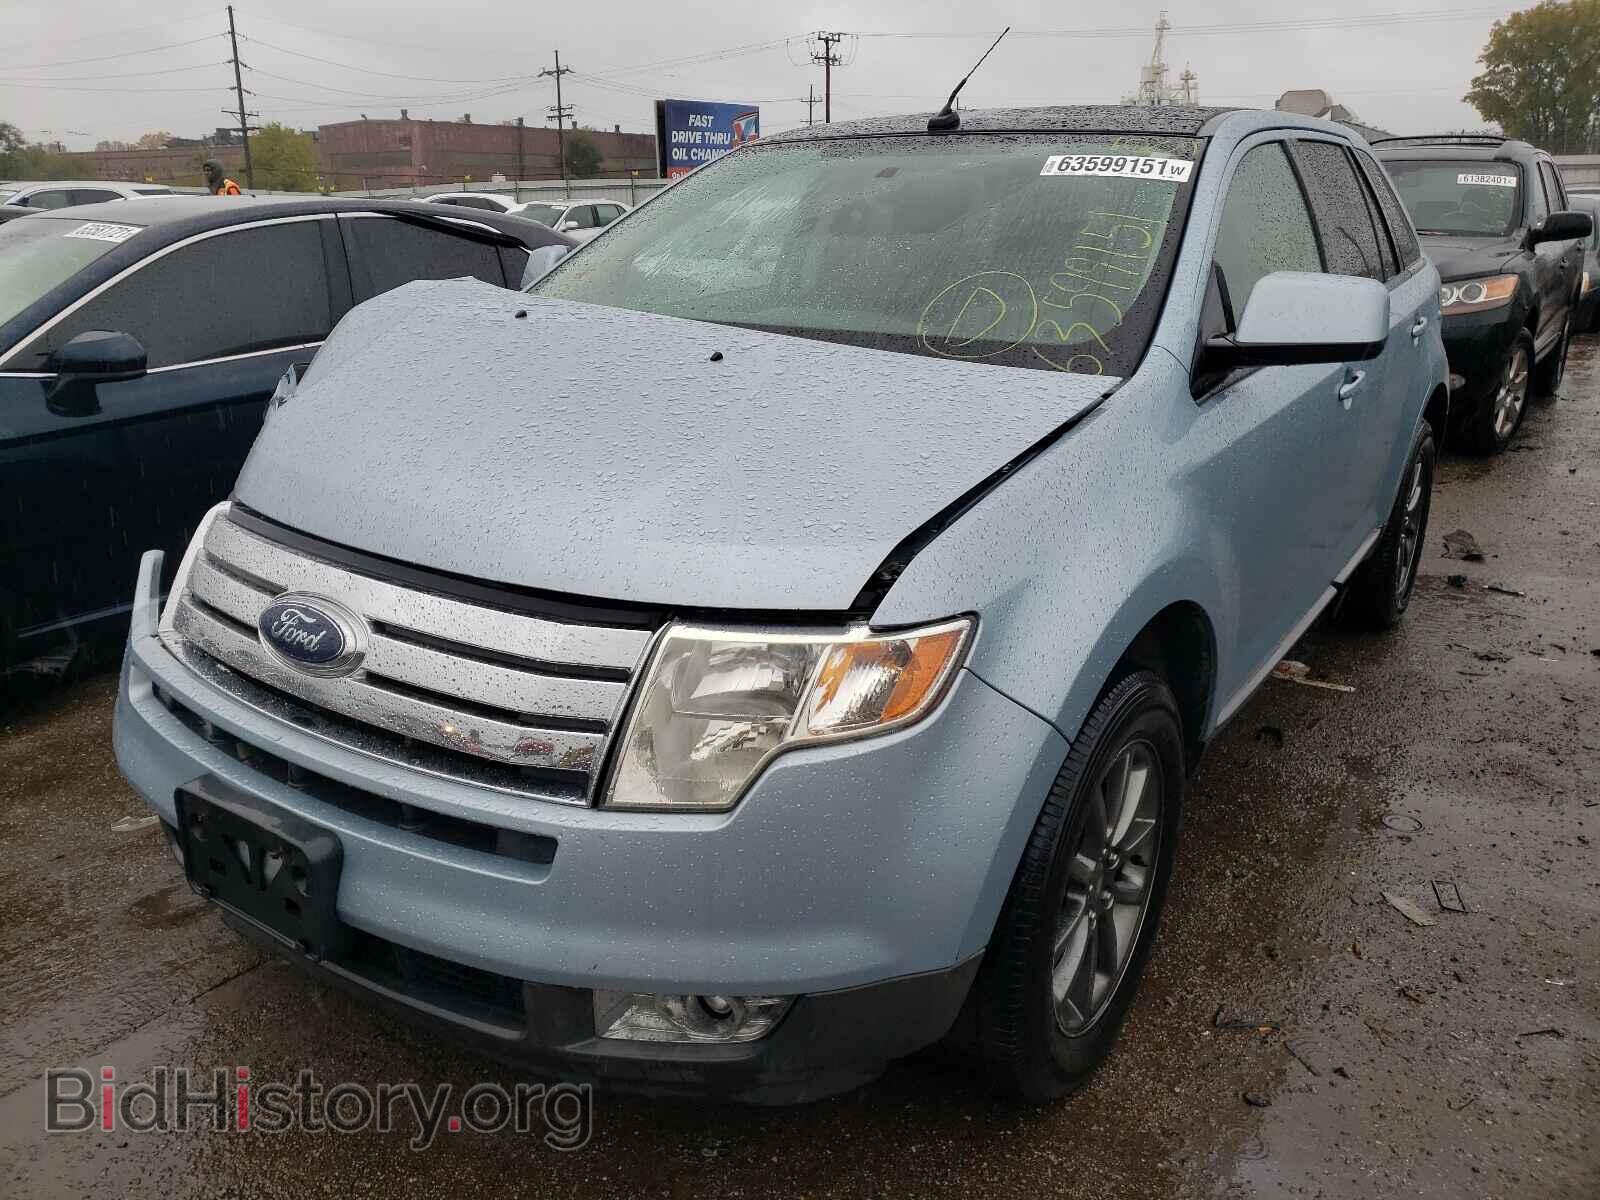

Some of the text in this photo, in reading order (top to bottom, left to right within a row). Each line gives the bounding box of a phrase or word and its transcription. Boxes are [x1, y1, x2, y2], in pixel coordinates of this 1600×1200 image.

[688, 114, 714, 128] FAST
[671, 130, 731, 145] DRIVE THRU
[671, 147, 729, 161] OIL CHAN
[944, 287, 1006, 346] D
[272, 608, 327, 652] Ford
